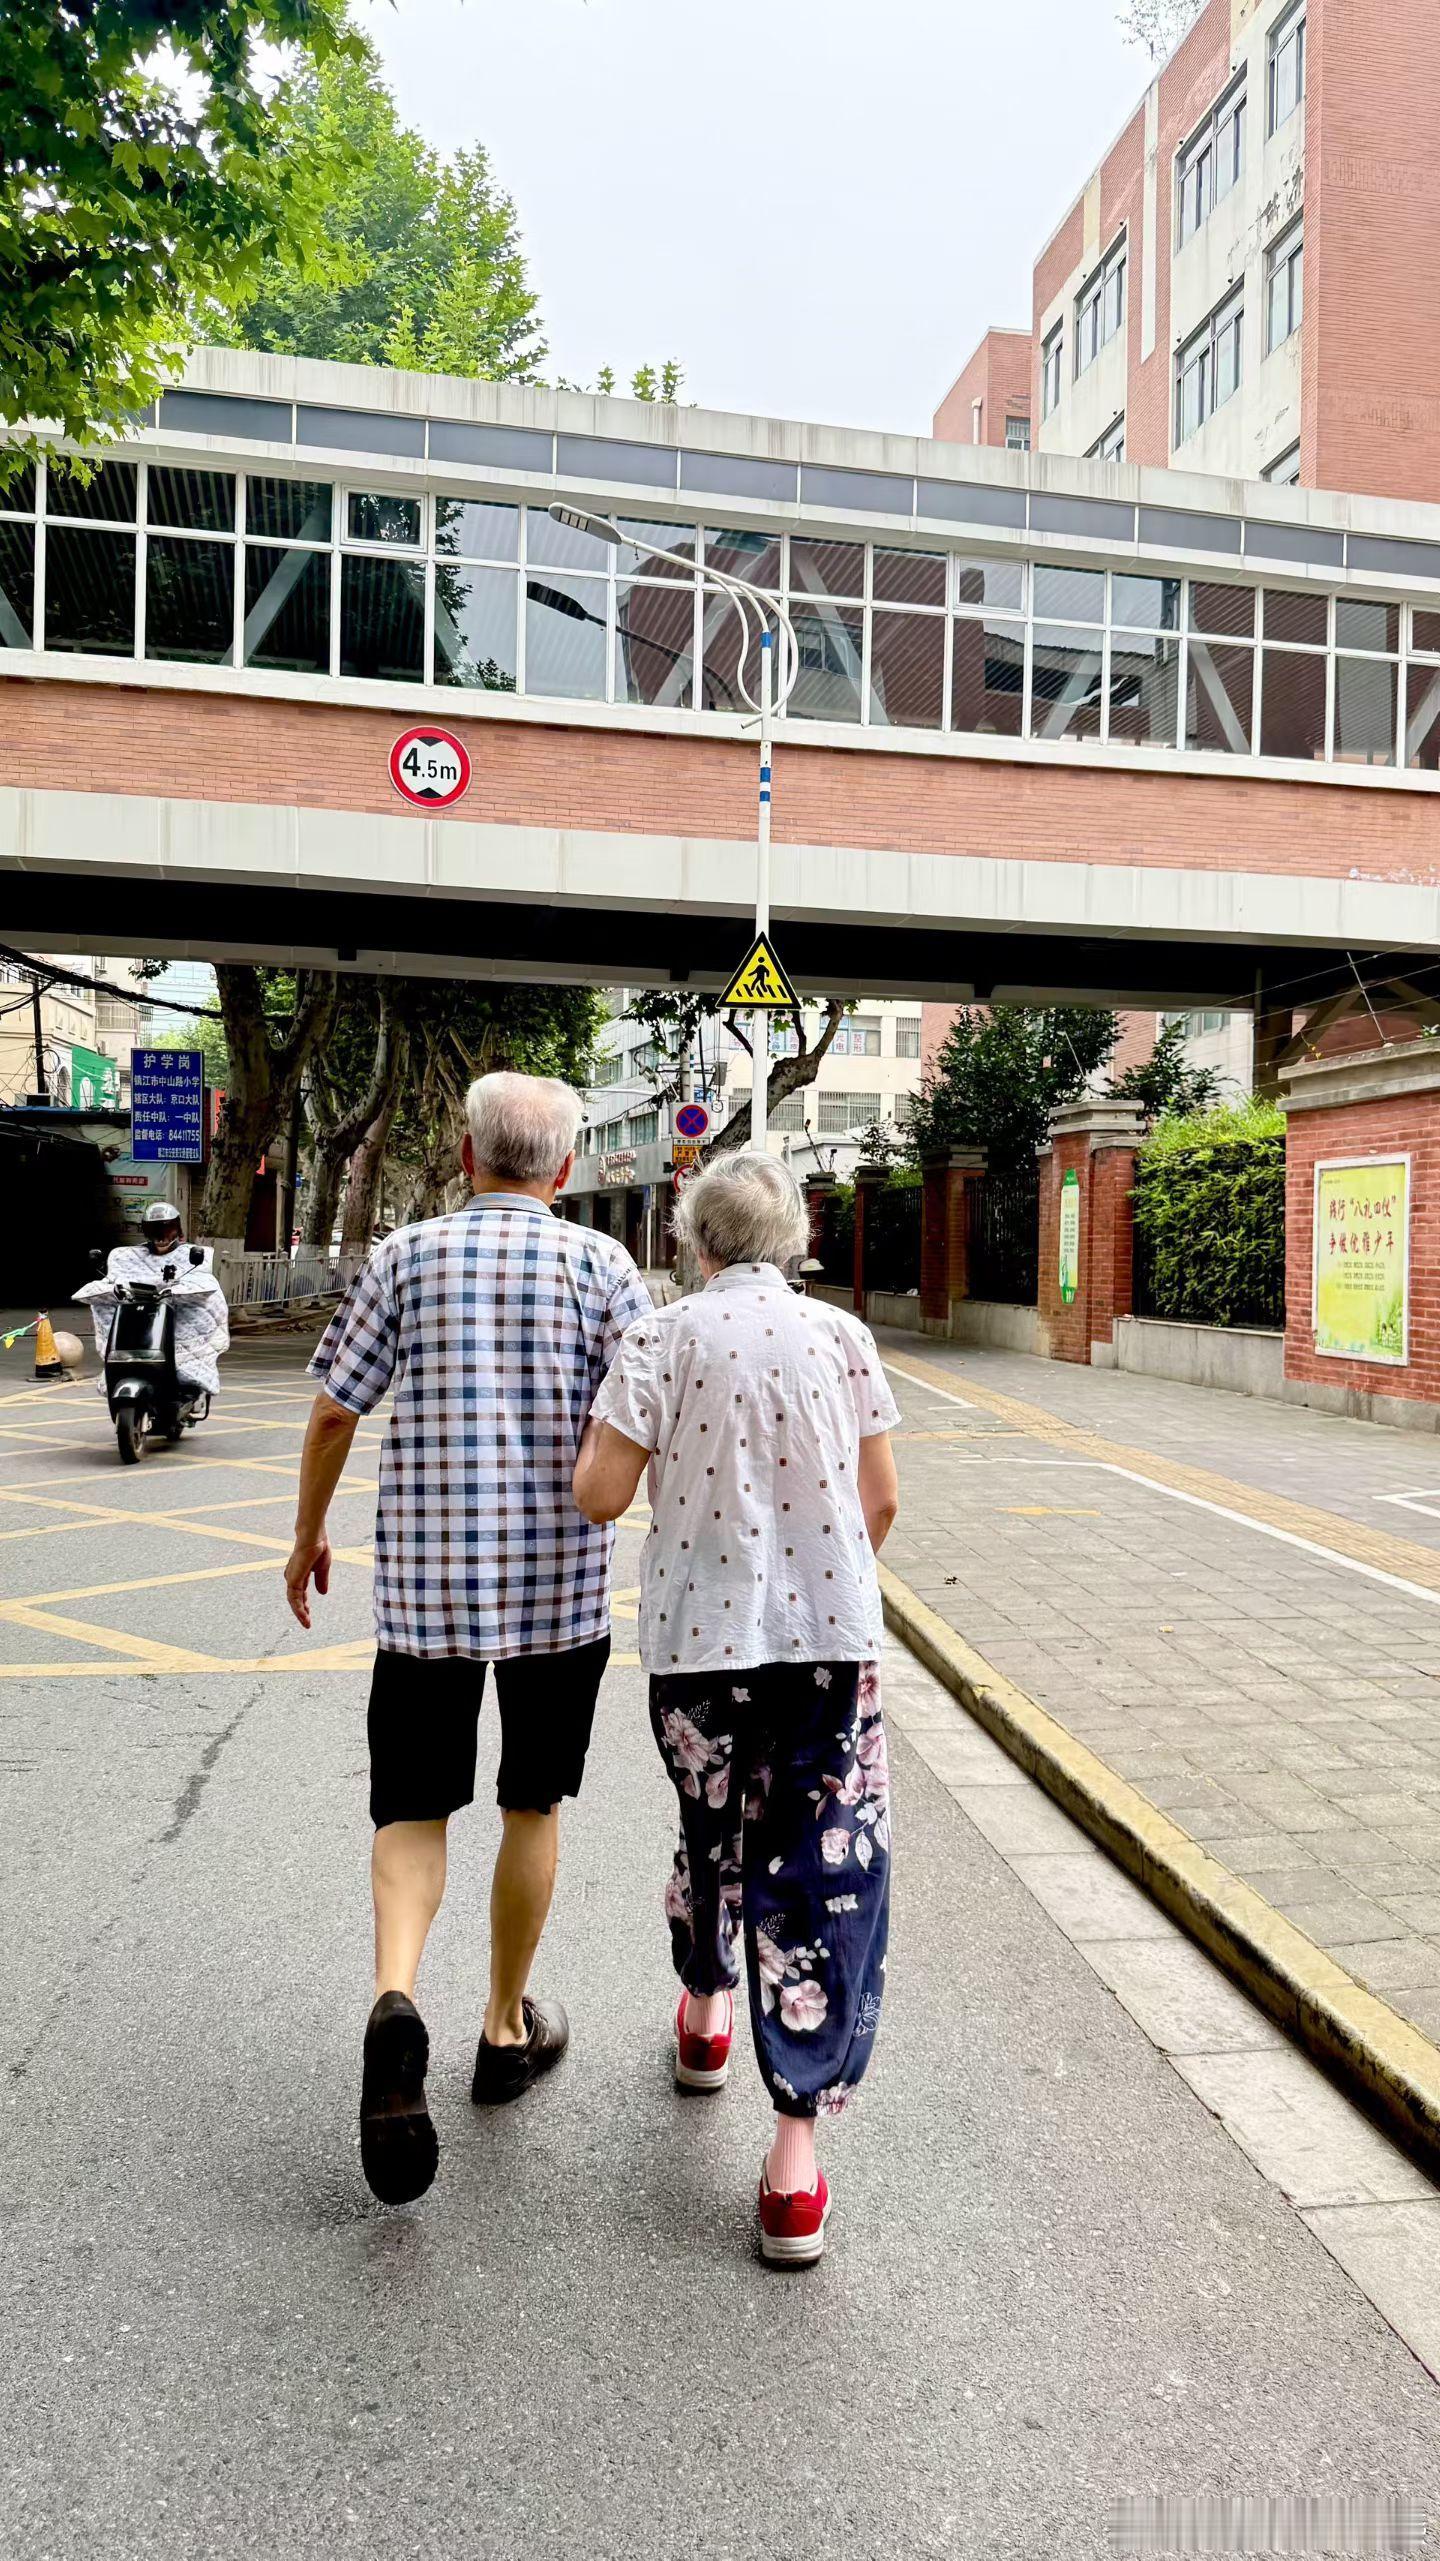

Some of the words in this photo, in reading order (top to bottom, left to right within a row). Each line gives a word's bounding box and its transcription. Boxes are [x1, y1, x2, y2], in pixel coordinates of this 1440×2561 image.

[402, 747, 457, 780] 4.5m
[143, 1053, 190, 1069] 护学岗
[134, 1074, 200, 1087] 镇江市中山路小学
